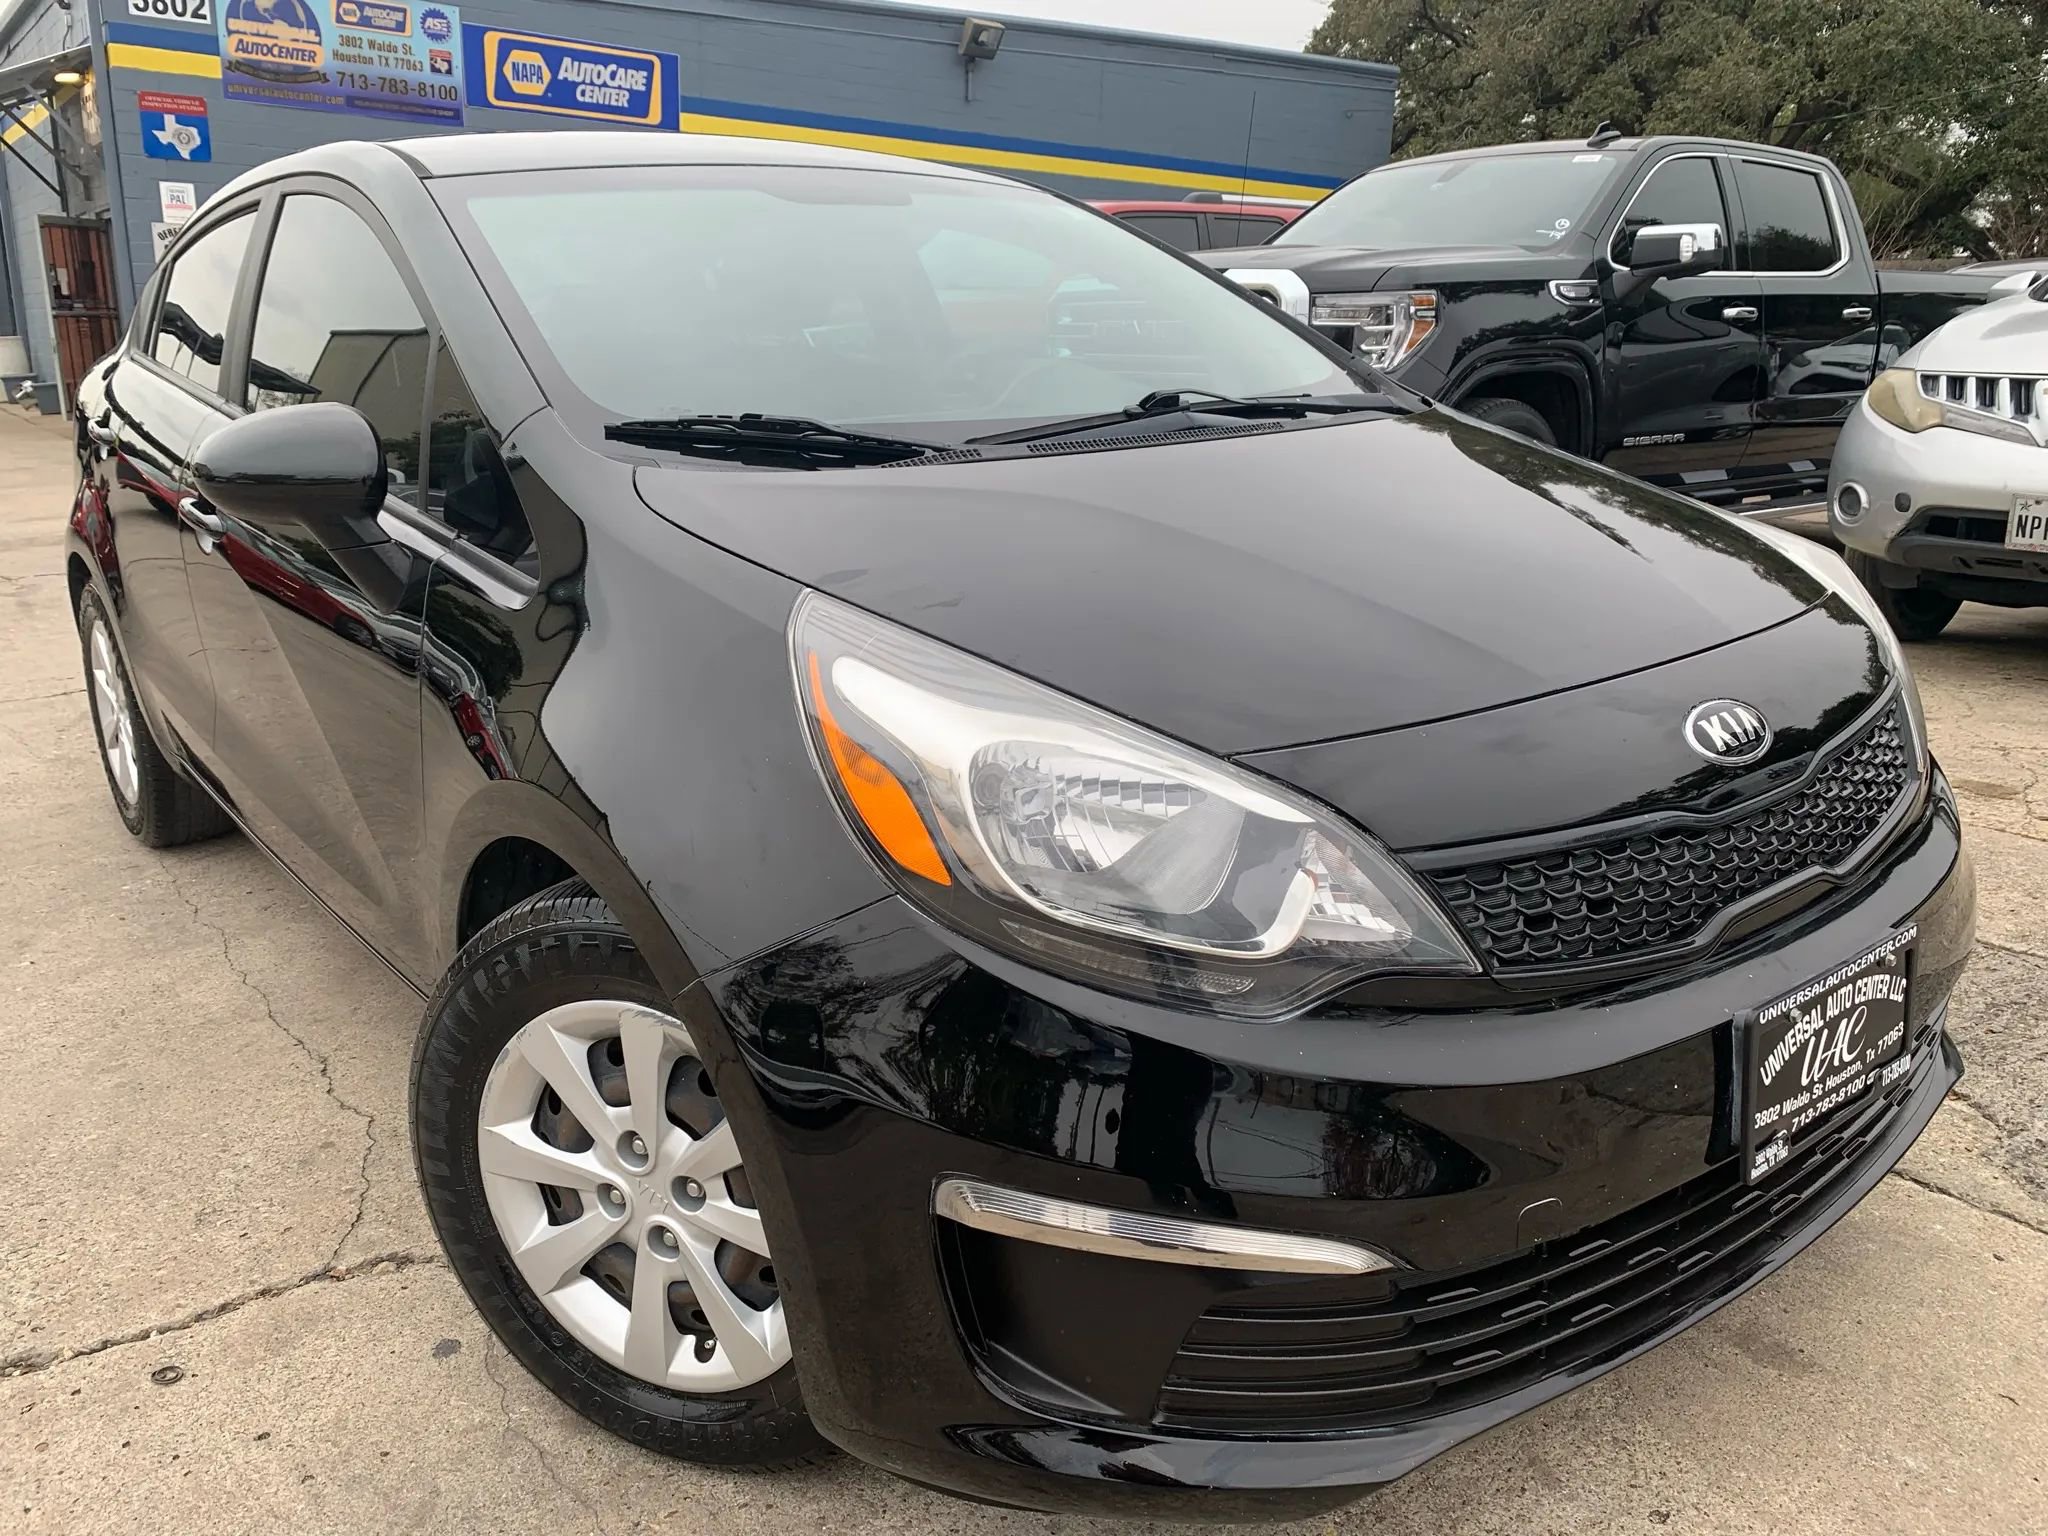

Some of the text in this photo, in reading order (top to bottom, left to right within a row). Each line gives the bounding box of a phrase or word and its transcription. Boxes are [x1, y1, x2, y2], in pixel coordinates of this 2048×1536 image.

[424, 17, 449, 31] ASE
[338, 34, 363, 50] 3802
[367, 38, 399, 54] Waldo
[401, 43, 416, 57] St.
[332, 49, 424, 72] Houston TX 77063
[510, 60, 545, 86] NAPA
[336, 71, 459, 102] 713-783-8100
[575, 84, 630, 108] CENTER
[169, 194, 187, 205] PAL
[1623, 433, 1686, 447] SIERRA
[1696, 707, 1766, 752] KIA
[1759, 925, 1918, 1025] UNIVERSALAUTOCENTER.COM
[1759, 974, 1908, 1087] UNIVERSAL AUTO CENTER LLC
[1754, 1103, 1781, 1129] 3802
[1782, 1090, 1811, 1116] Waldo
[1811, 1083, 1824, 1100] St
[1825, 1060, 1863, 1092] Houston,
[1877, 1021, 1905, 1055] 77063
[1791, 1074, 1866, 1133] 713-783-8100
